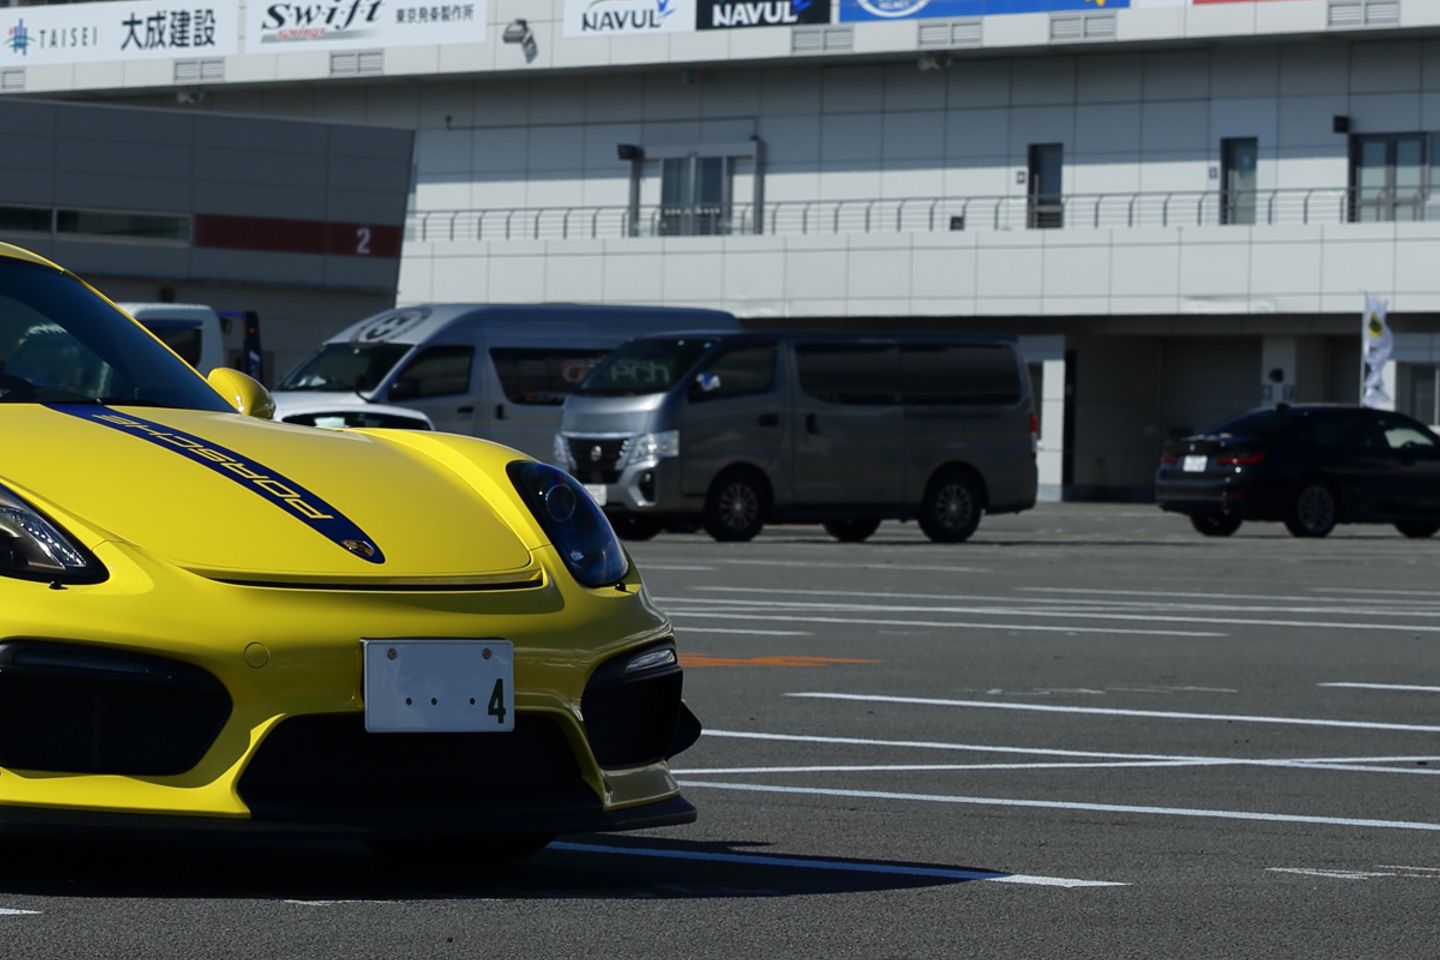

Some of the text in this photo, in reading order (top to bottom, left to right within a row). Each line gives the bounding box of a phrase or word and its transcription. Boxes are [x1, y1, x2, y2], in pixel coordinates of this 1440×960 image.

[582, 8, 661, 32] NAVUL
[712, 1, 798, 27] NAVUL
[38, 27, 98, 49] TAISEI
[120, 9, 217, 51] 大成建設
[356, 227, 371, 254] 2
[92, 414, 334, 520] PORSCHE
